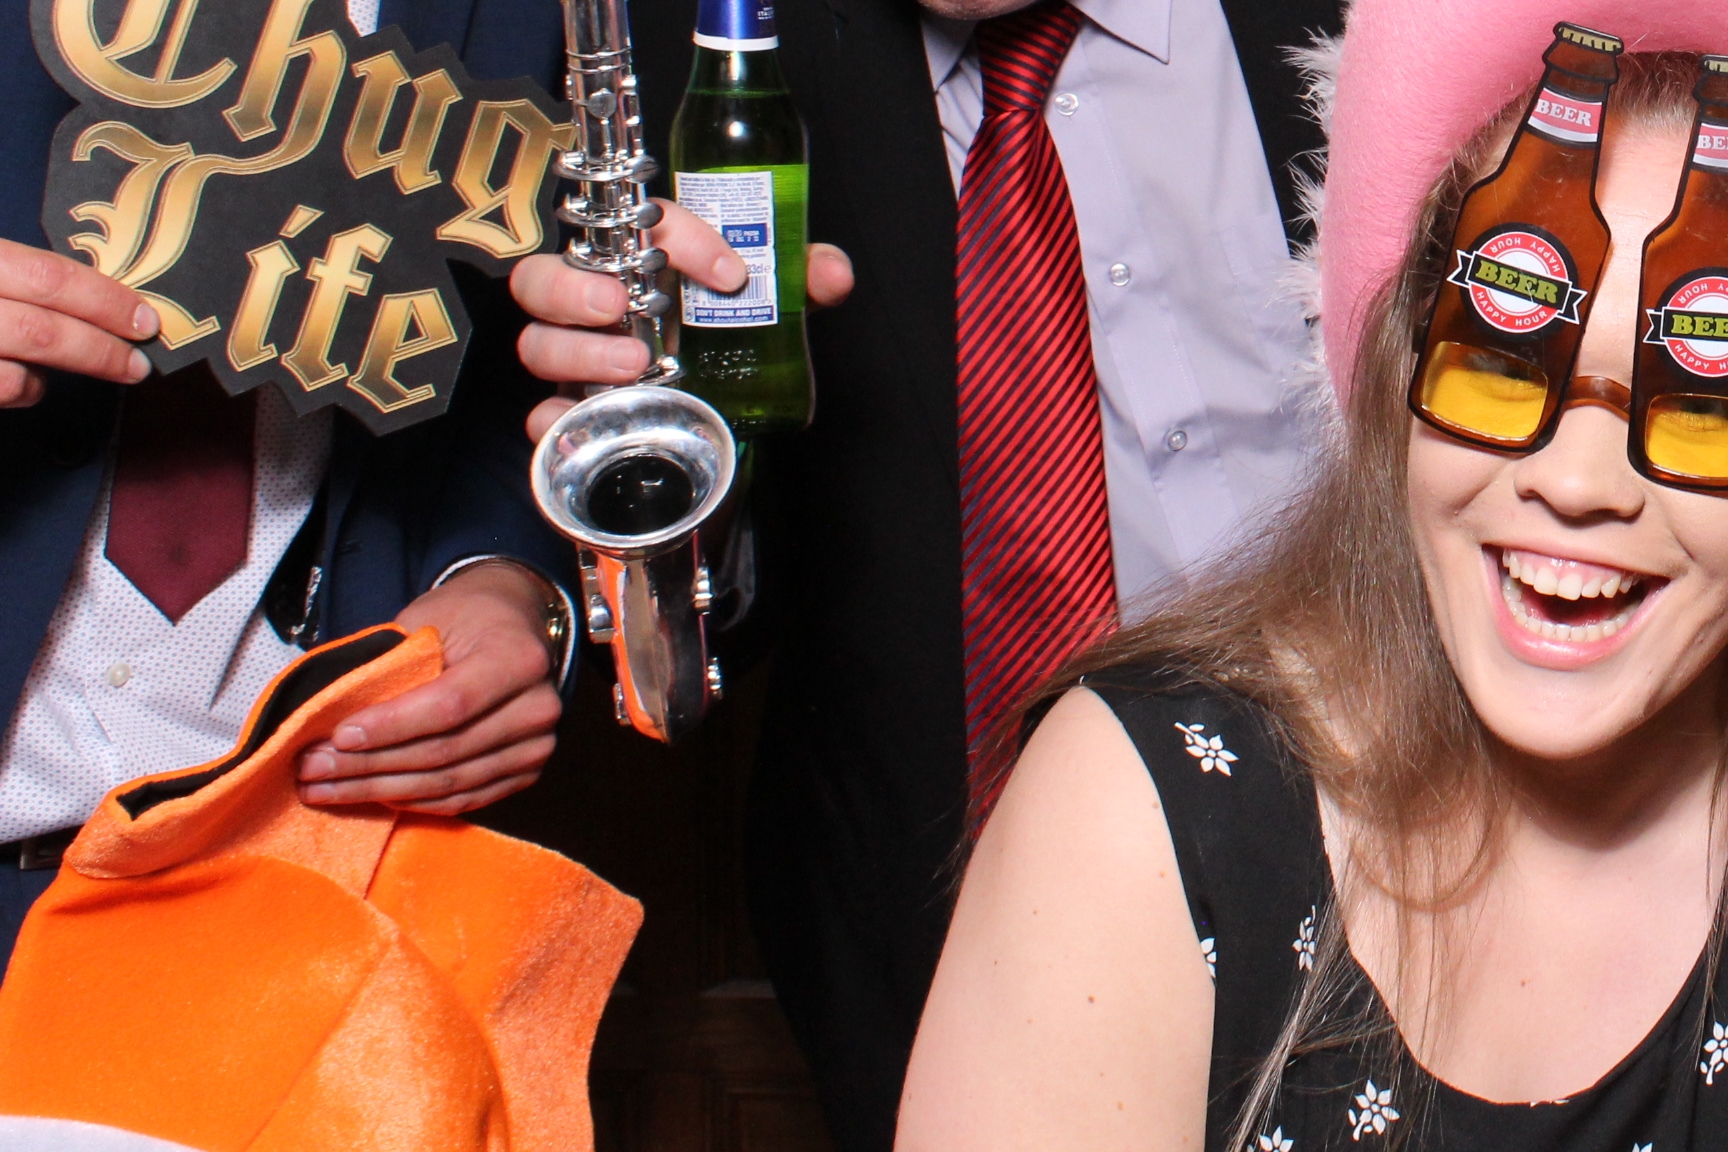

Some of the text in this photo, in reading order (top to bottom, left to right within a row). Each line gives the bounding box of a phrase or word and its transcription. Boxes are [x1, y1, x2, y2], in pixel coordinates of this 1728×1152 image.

[1536, 98, 1592, 127] BEER
[69, 121, 458, 414] Life
[1490, 237, 1561, 273] HAPPY HOUR
[1475, 259, 1559, 304] BEER
[1677, 283, 1708, 304] HOUR
[752, 308, 772, 316] DRIVE
[1477, 291, 1547, 326] HAPPY HOUR
[1675, 343, 1709, 370] HAPPY
